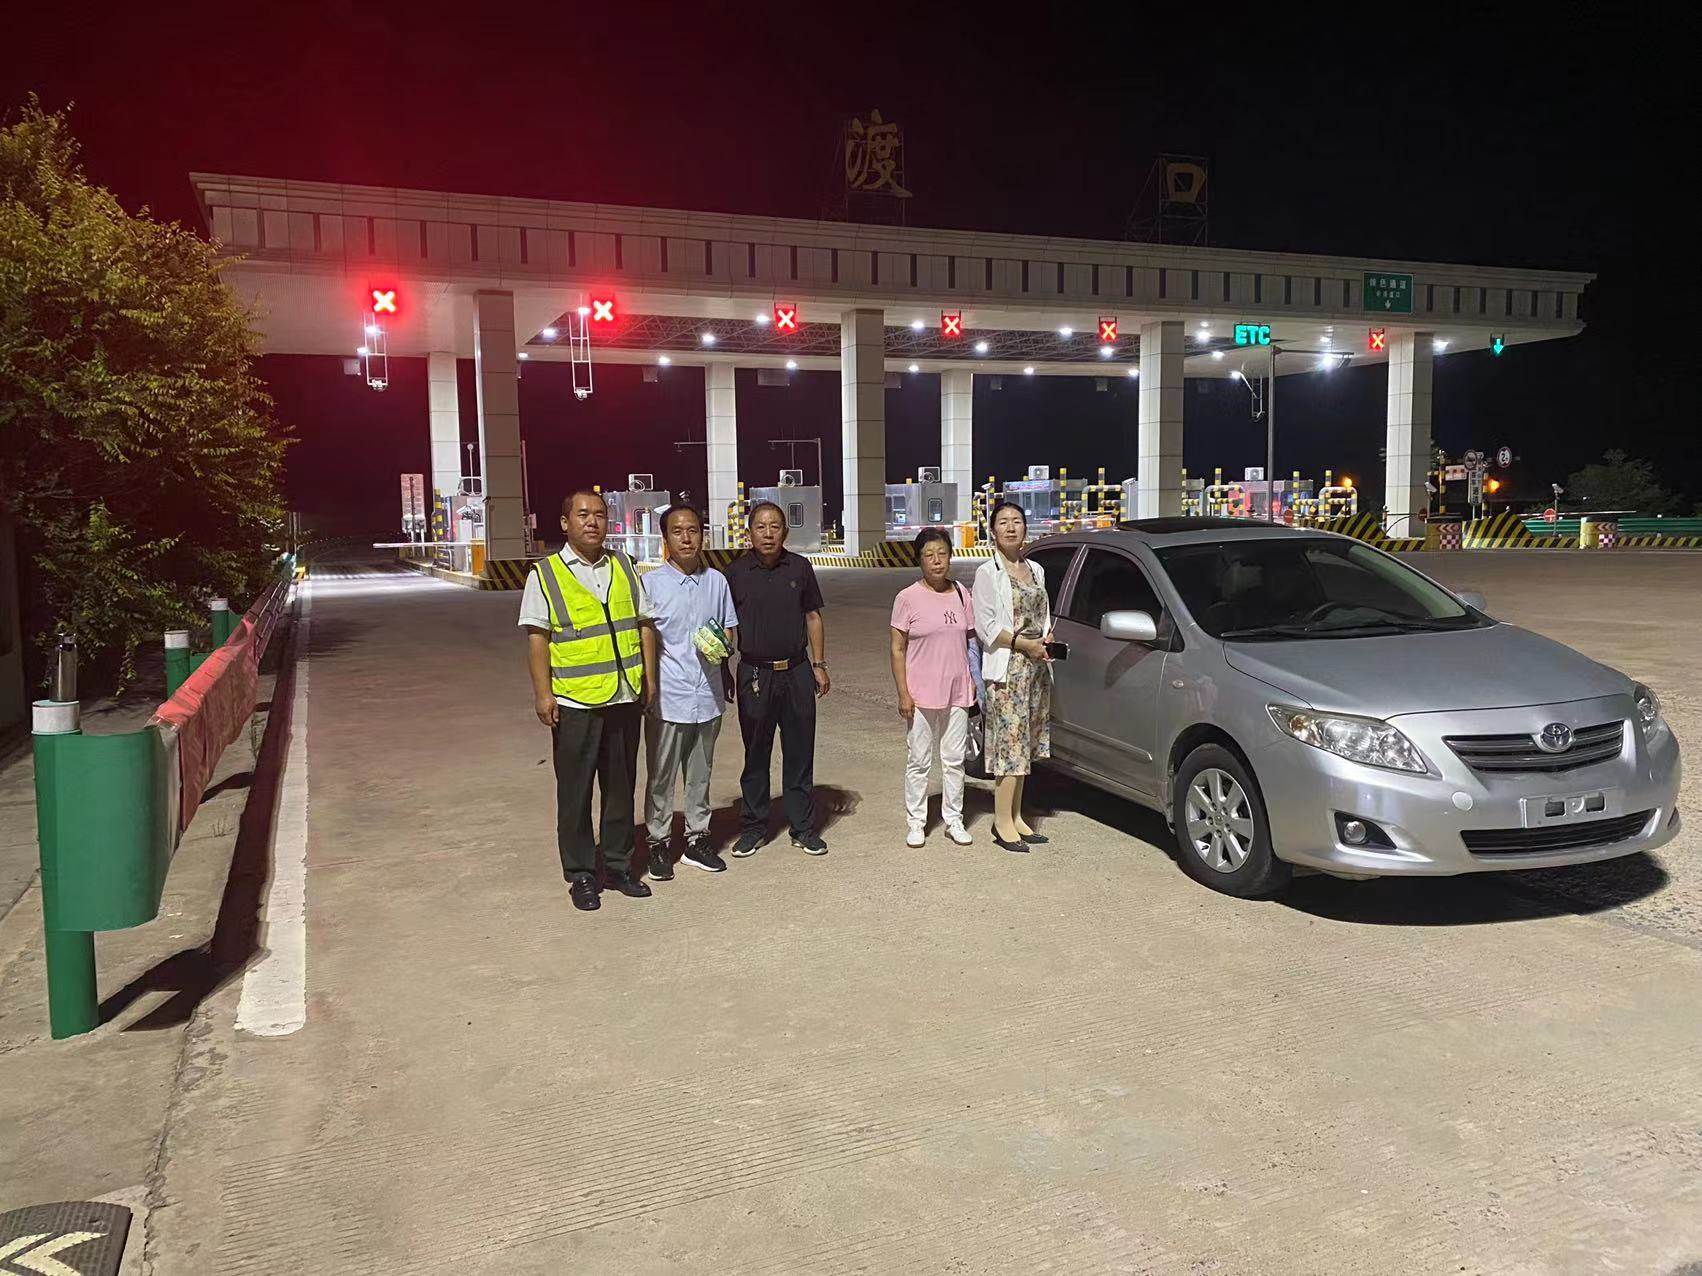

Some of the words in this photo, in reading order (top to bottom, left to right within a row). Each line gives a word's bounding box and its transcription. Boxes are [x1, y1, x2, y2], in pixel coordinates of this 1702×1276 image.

[846, 108, 913, 198] 渡
[1165, 162, 1207, 202] 口
[1235, 324, 1271, 346] ETC
[943, 611, 958, 624] NY
